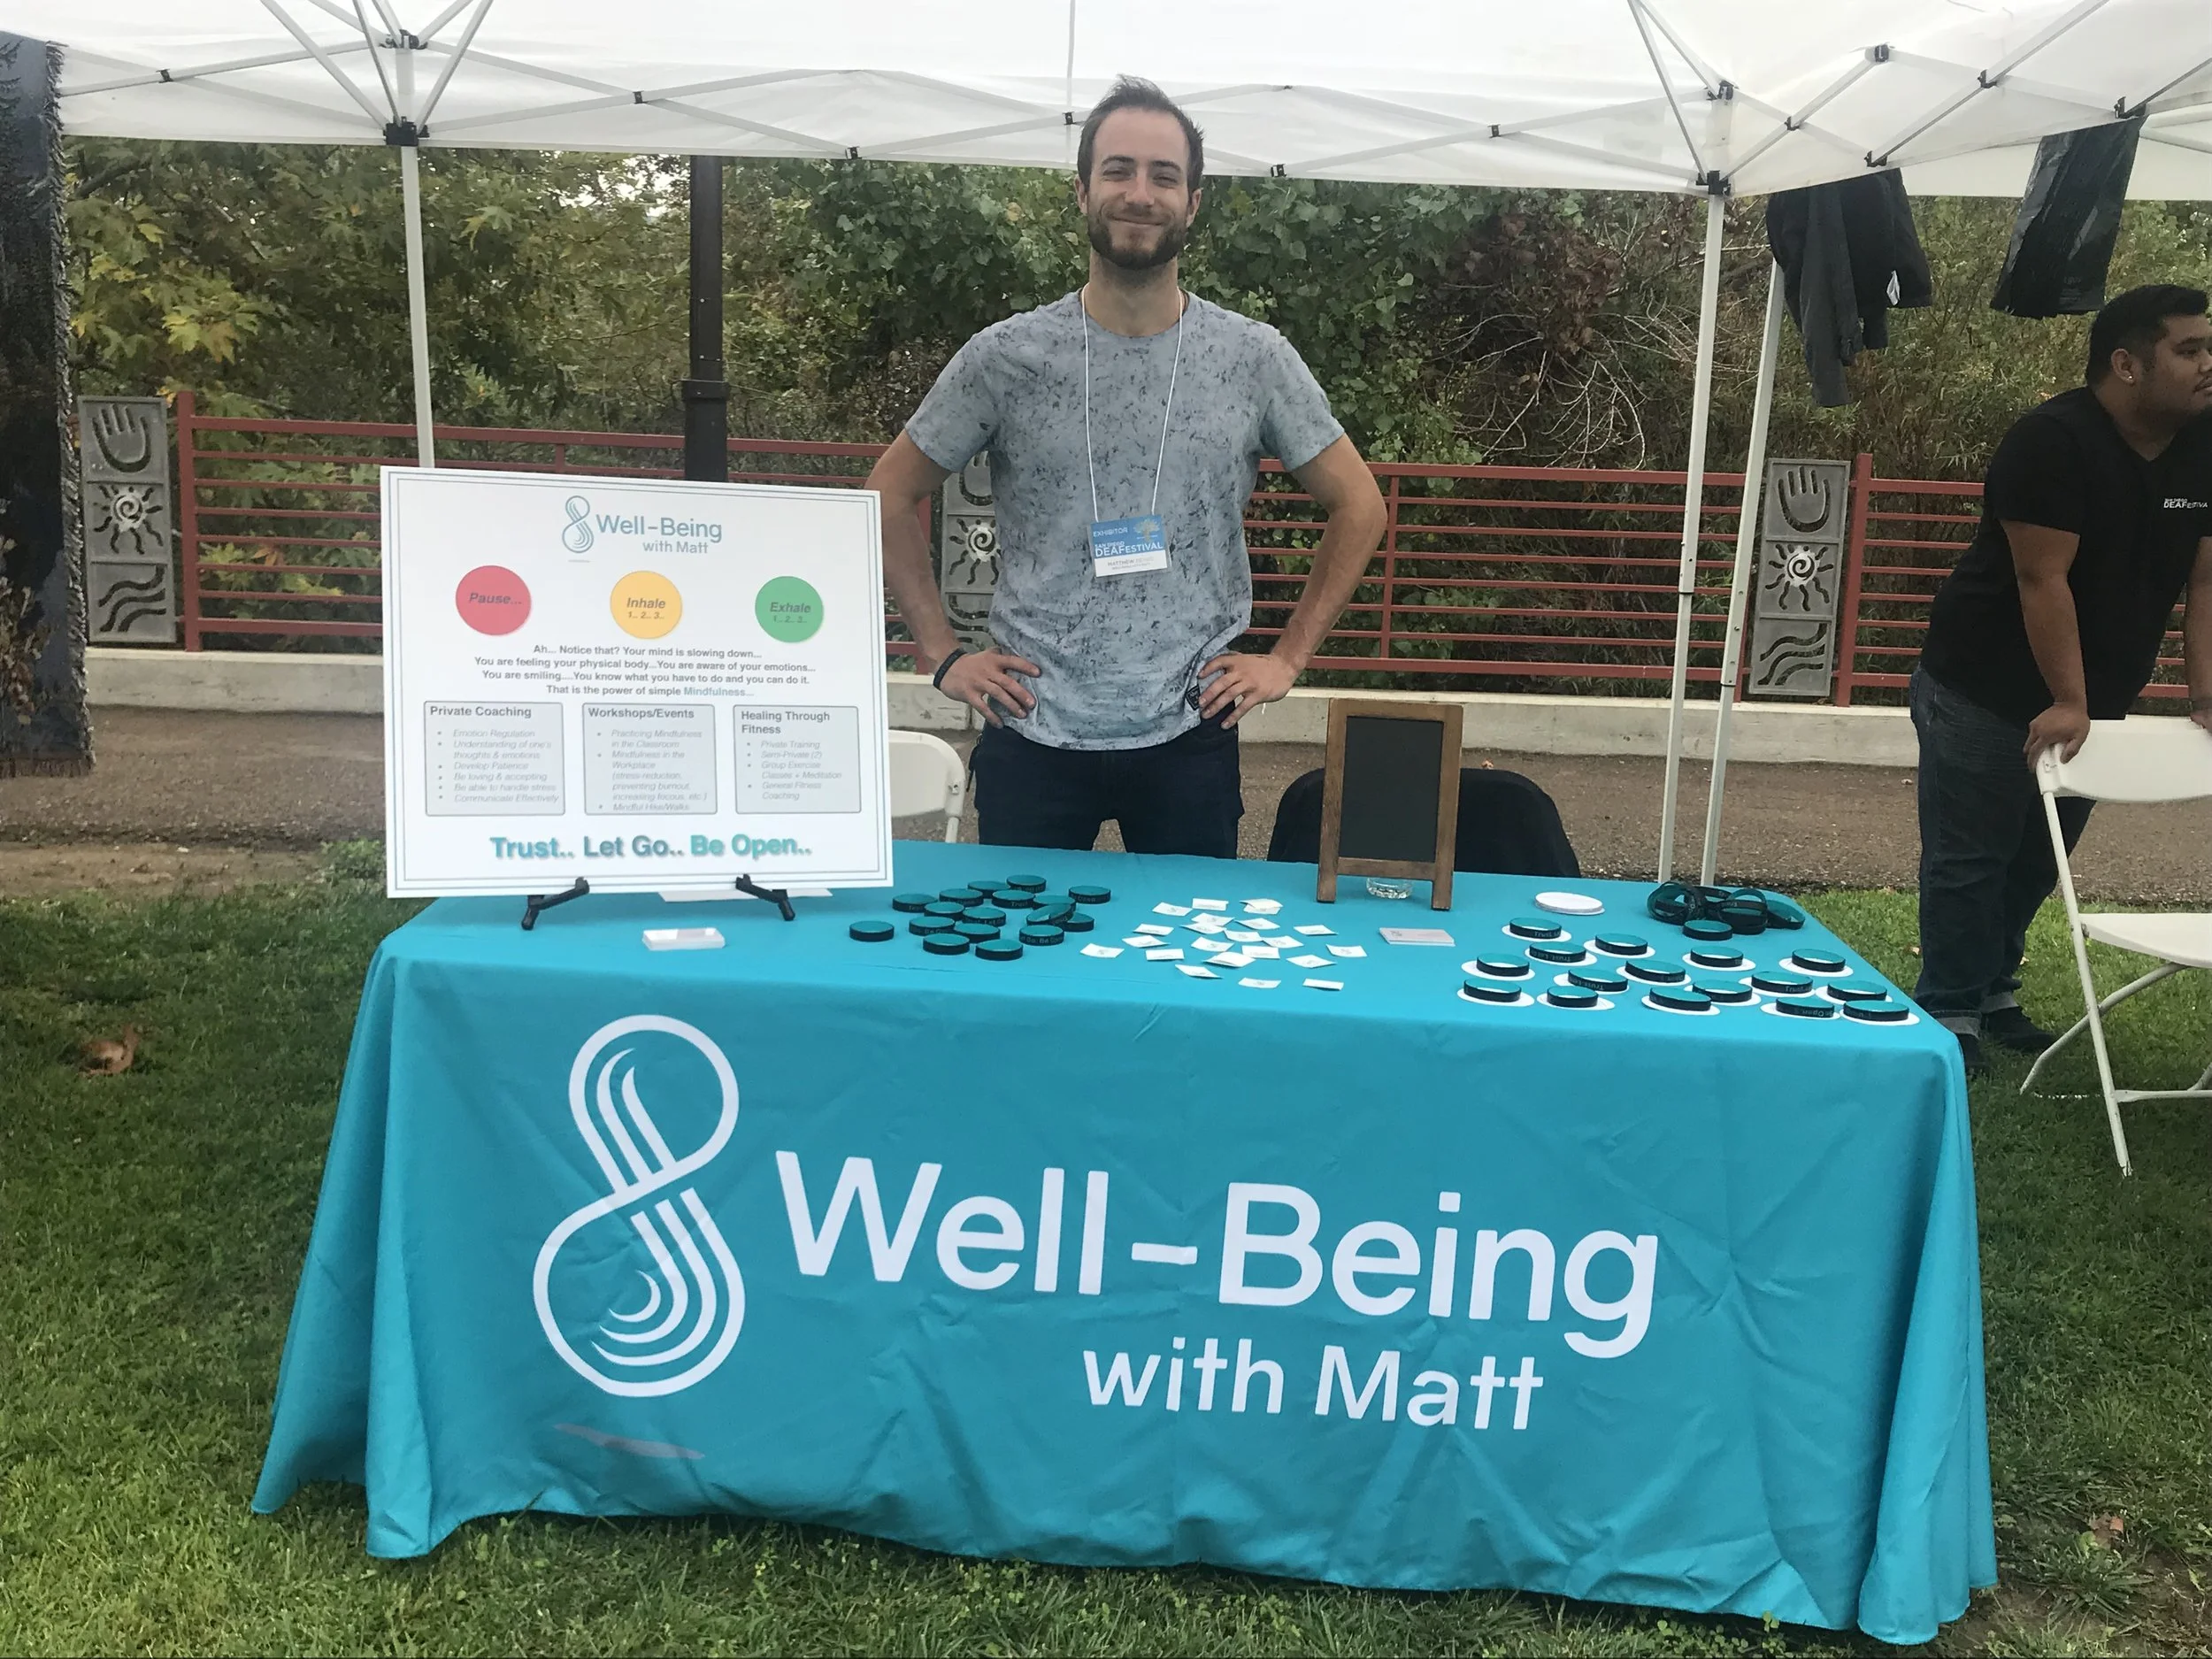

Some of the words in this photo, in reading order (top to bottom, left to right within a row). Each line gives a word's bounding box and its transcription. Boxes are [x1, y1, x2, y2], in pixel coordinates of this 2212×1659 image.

[595, 514, 722, 543] Well-Being
[1093, 526, 1128, 537] EXHIBITOR
[642, 540, 672, 552] with
[676, 541, 709, 554] Matt
[1094, 541, 1164, 557] DEAFESTIVAL
[469, 592, 523, 604] Pause...
[626, 597, 666, 609] Inhale
[770, 602, 811, 613] Exhale
[534, 645, 557, 654] Ah...
[559, 645, 592, 655] Notice
[595, 646, 619, 655] that?
[623, 646, 646, 656] Your
[649, 648, 672, 657] mind
[676, 648, 684, 657] is
[687, 648, 725, 659] slowing
[727, 649, 763, 658] down...
[474, 657, 494, 665] You
[516, 657, 550, 669] feeling
[554, 660, 577, 669] your
[580, 658, 621, 669] physical
[727, 662, 738, 671] of
[740, 664, 761, 673] your
[764, 663, 816, 672] emotions...
[482, 670, 502, 680] You
[595, 672, 622, 681] know
[625, 672, 649, 681] what
[651, 675, 669, 684] you
[672, 672, 695, 683] have
[698, 673, 708, 683] to
[710, 674, 723, 683] do
[726, 674, 743, 684] and
[747, 677, 764, 686] you
[786, 675, 798, 685] do
[801, 675, 810, 685] it.
[546, 685, 569, 694] That
[572, 685, 580, 694] is
[583, 685, 600, 695] the
[602, 687, 634, 696] power
[635, 686, 646, 695] of
[649, 687, 681, 697] simple
[430, 706, 472, 717] Private
[475, 706, 532, 718] Coaching
[588, 708, 695, 720] Workshops/Events
[741, 711, 782, 723] Healing
[786, 711, 830, 723] Through
[490, 729, 535, 739] Regulation
[611, 729, 652, 740] Practicing
[741, 725, 781, 734] Fitness
[453, 741, 517, 749] Understanding
[635, 740, 680, 749] Classroom
[789, 741, 820, 750] Training
[453, 751, 491, 760] thoughts
[612, 761, 657, 770] Workplace
[761, 761, 786, 770] Group
[468, 773, 494, 782] loving
[504, 773, 547, 782] accepting
[762, 792, 800, 801] Coaching
[490, 836, 575, 859] Trust..
[583, 835, 625, 858] Let
[632, 835, 684, 857] Go..
[690, 834, 725, 856] Be
[731, 833, 812, 860] Open..
[774, 1149, 1659, 1360] Well-Being
[1082, 1337, 1284, 1415] with
[1314, 1345, 1544, 1431] Matt
